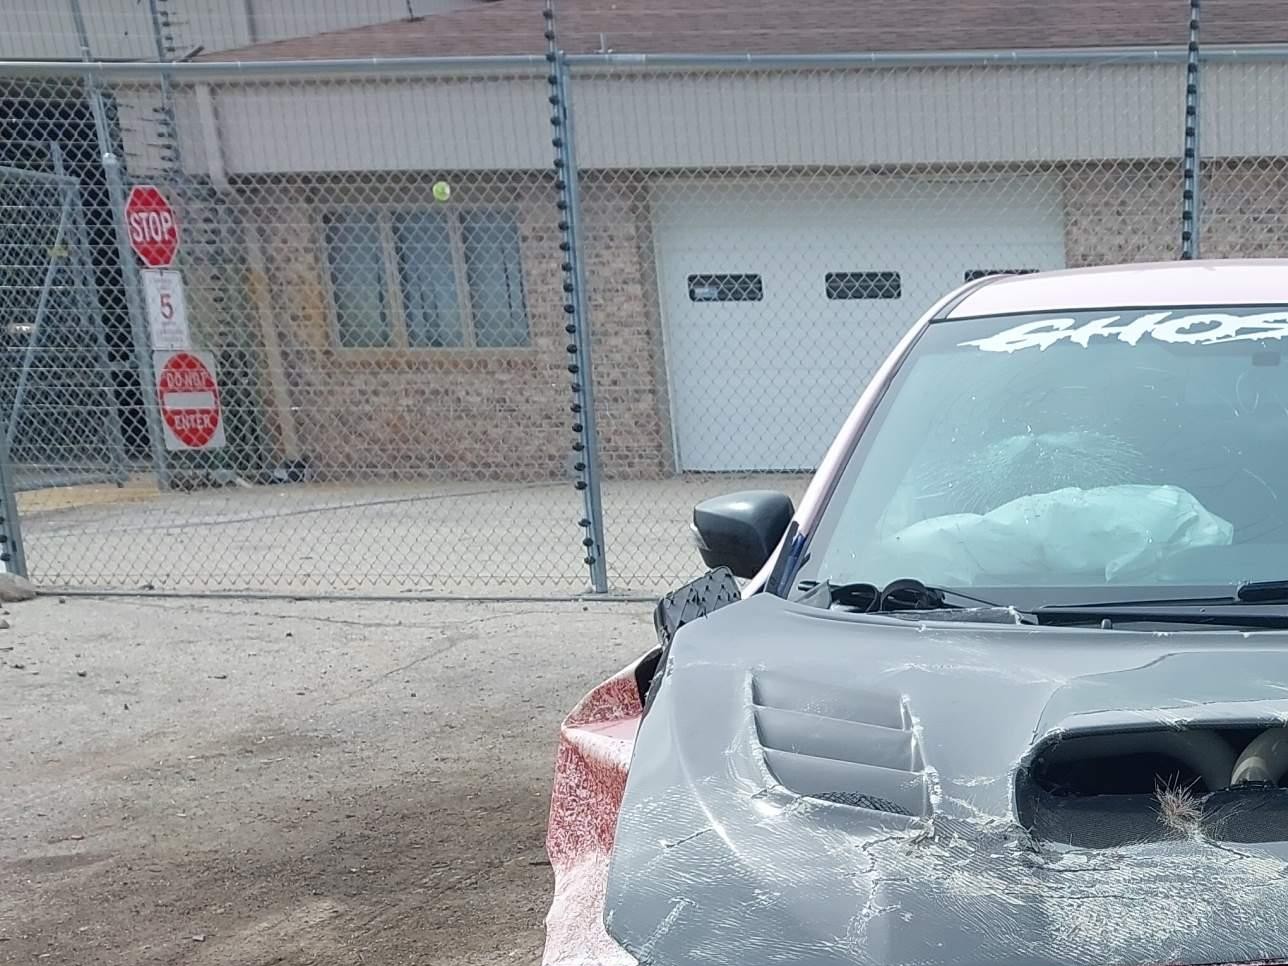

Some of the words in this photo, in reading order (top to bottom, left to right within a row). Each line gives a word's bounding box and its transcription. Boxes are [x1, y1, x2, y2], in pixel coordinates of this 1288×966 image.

[130, 211, 172, 242] STOP
[160, 293, 174, 319] 5
[166, 371, 182, 388] DO
[184, 371, 208, 387] NOT
[174, 414, 210, 430] ENTER
